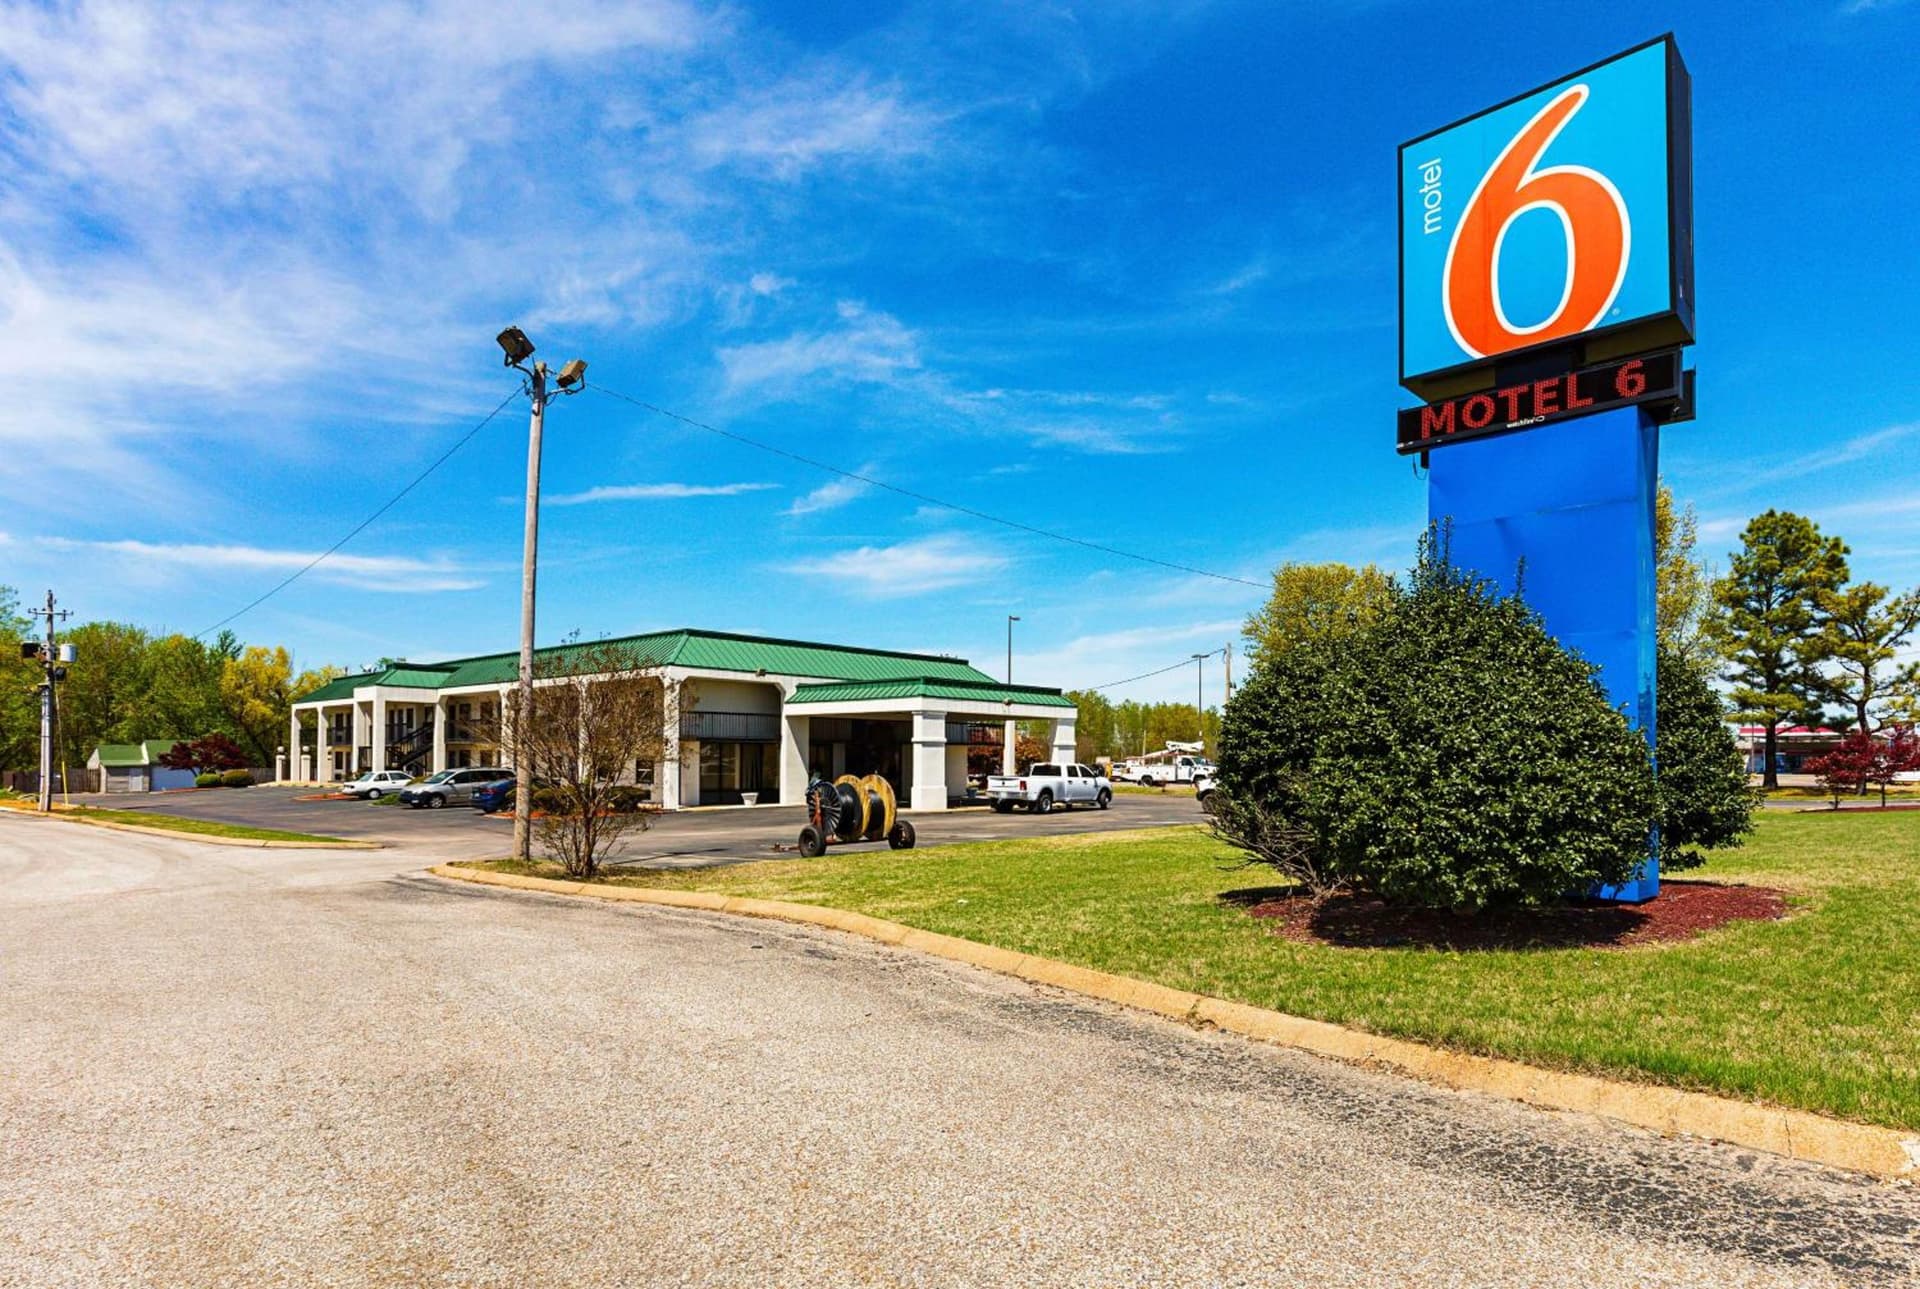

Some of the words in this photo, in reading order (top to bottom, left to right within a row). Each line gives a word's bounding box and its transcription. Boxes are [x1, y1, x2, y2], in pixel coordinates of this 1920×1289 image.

[1418, 158, 1442, 234] motel
[1443, 84, 1631, 358] 6
[1421, 373, 1593, 440] MOTEL
[1615, 359, 1646, 398] 6
